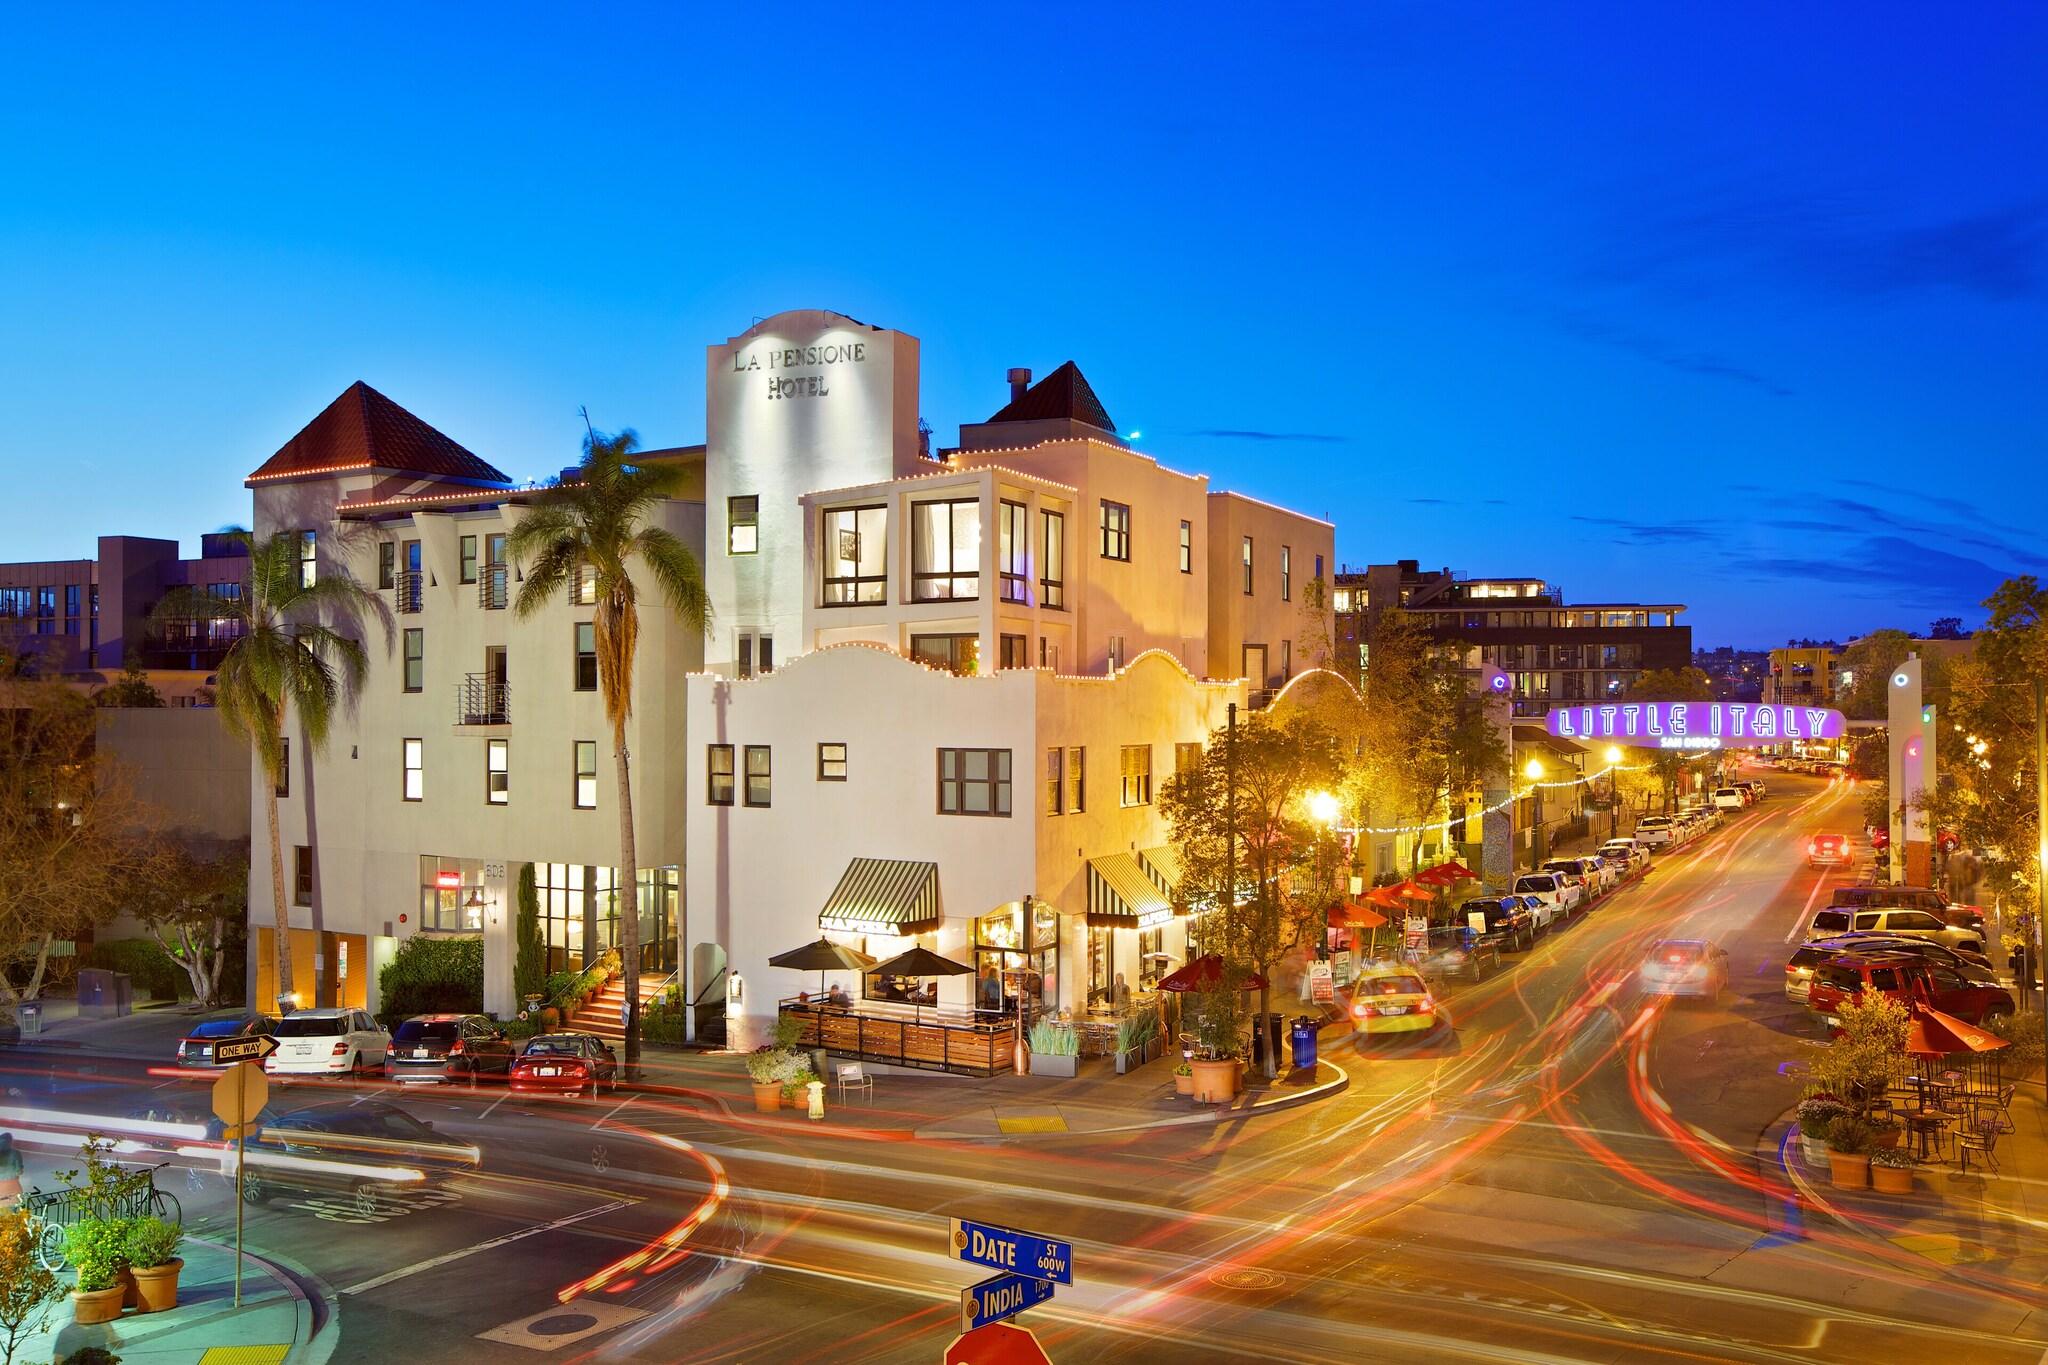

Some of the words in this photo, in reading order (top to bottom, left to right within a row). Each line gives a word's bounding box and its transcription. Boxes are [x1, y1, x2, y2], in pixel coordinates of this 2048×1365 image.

[733, 350, 761, 372] LA
[769, 343, 866, 369] PENSIONE
[768, 376, 829, 400] HOTEL
[1560, 704, 1687, 735] LITTLE
[1711, 705, 1827, 737] ITALY
[1661, 737, 1682, 748] SAN
[1684, 737, 1720, 748] DIEGO
[221, 1045, 240, 1057] ONE
[242, 1043, 262, 1053] WAY
[972, 1230, 1016, 1267] DATE
[1046, 1243, 1058, 1257] ST
[1037, 1256, 1066, 1273] 600W
[983, 1282, 1024, 1318] INDIA
